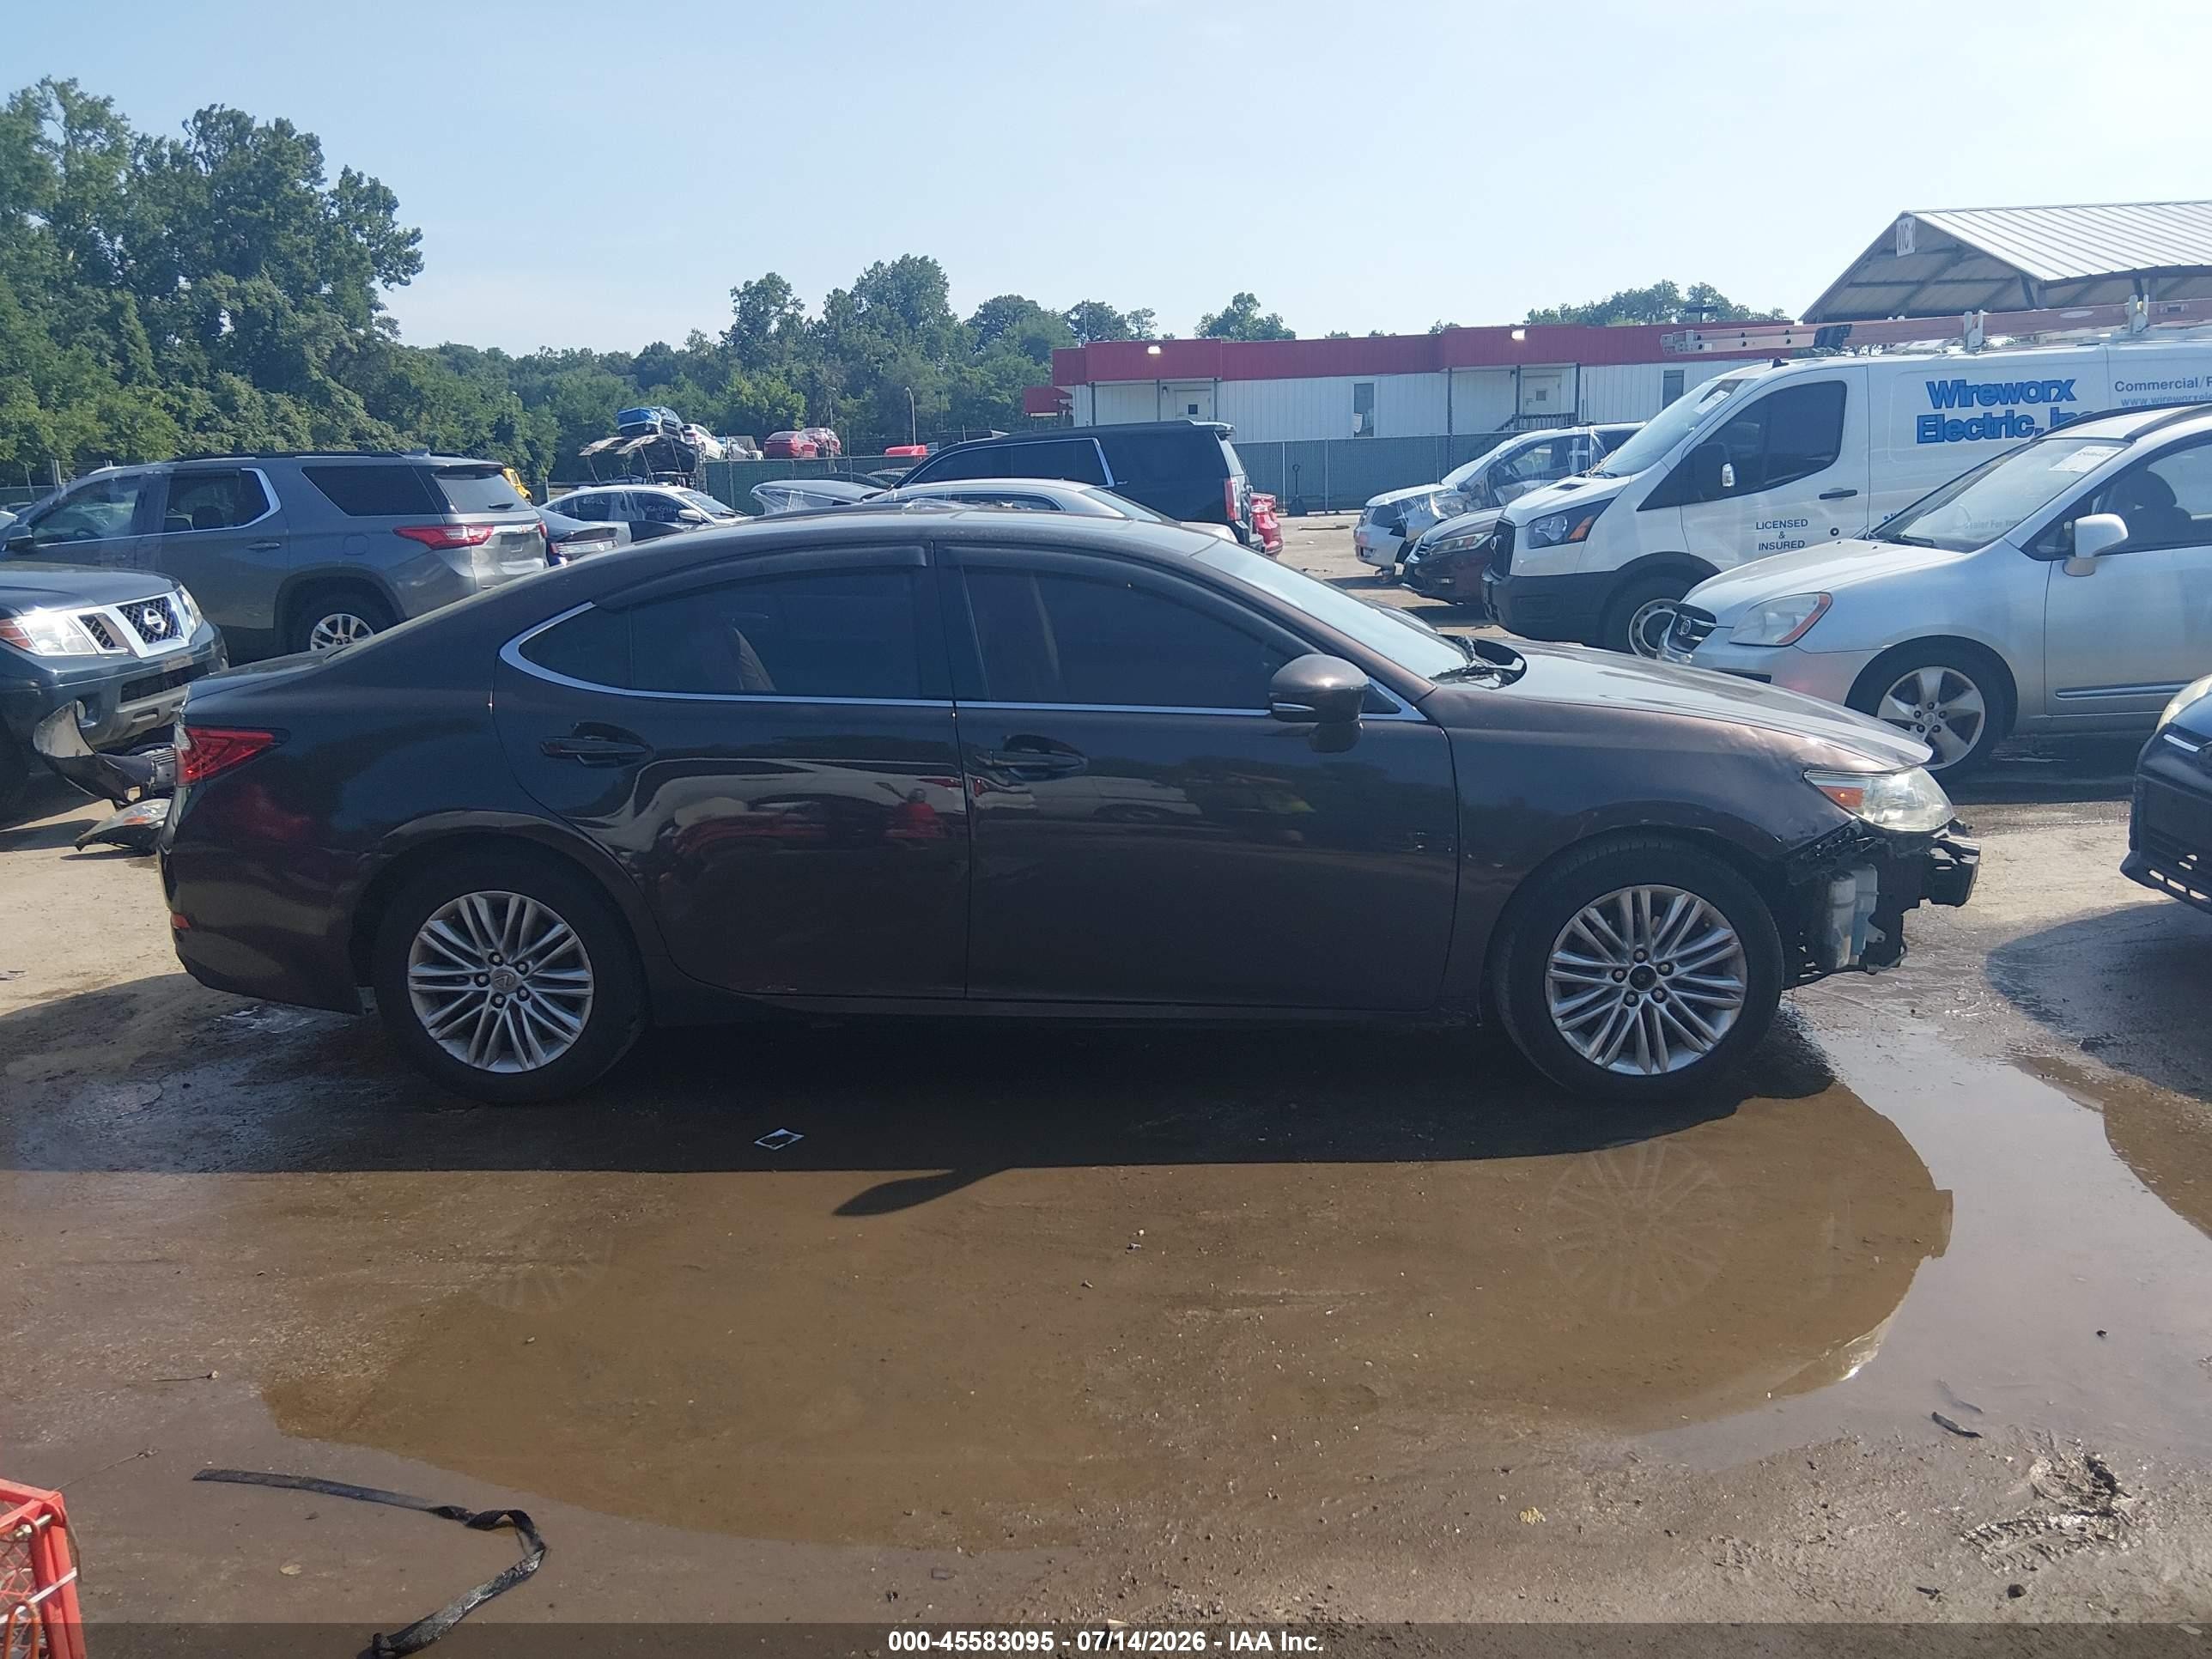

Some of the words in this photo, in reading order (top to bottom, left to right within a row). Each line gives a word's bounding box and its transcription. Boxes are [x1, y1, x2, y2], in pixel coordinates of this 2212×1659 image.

[1926, 379, 2077, 410] Wireworx
[1755, 519, 1808, 530] LICENSED
[1778, 531, 1786, 539] &
[1758, 540, 1805, 550] INSURED
